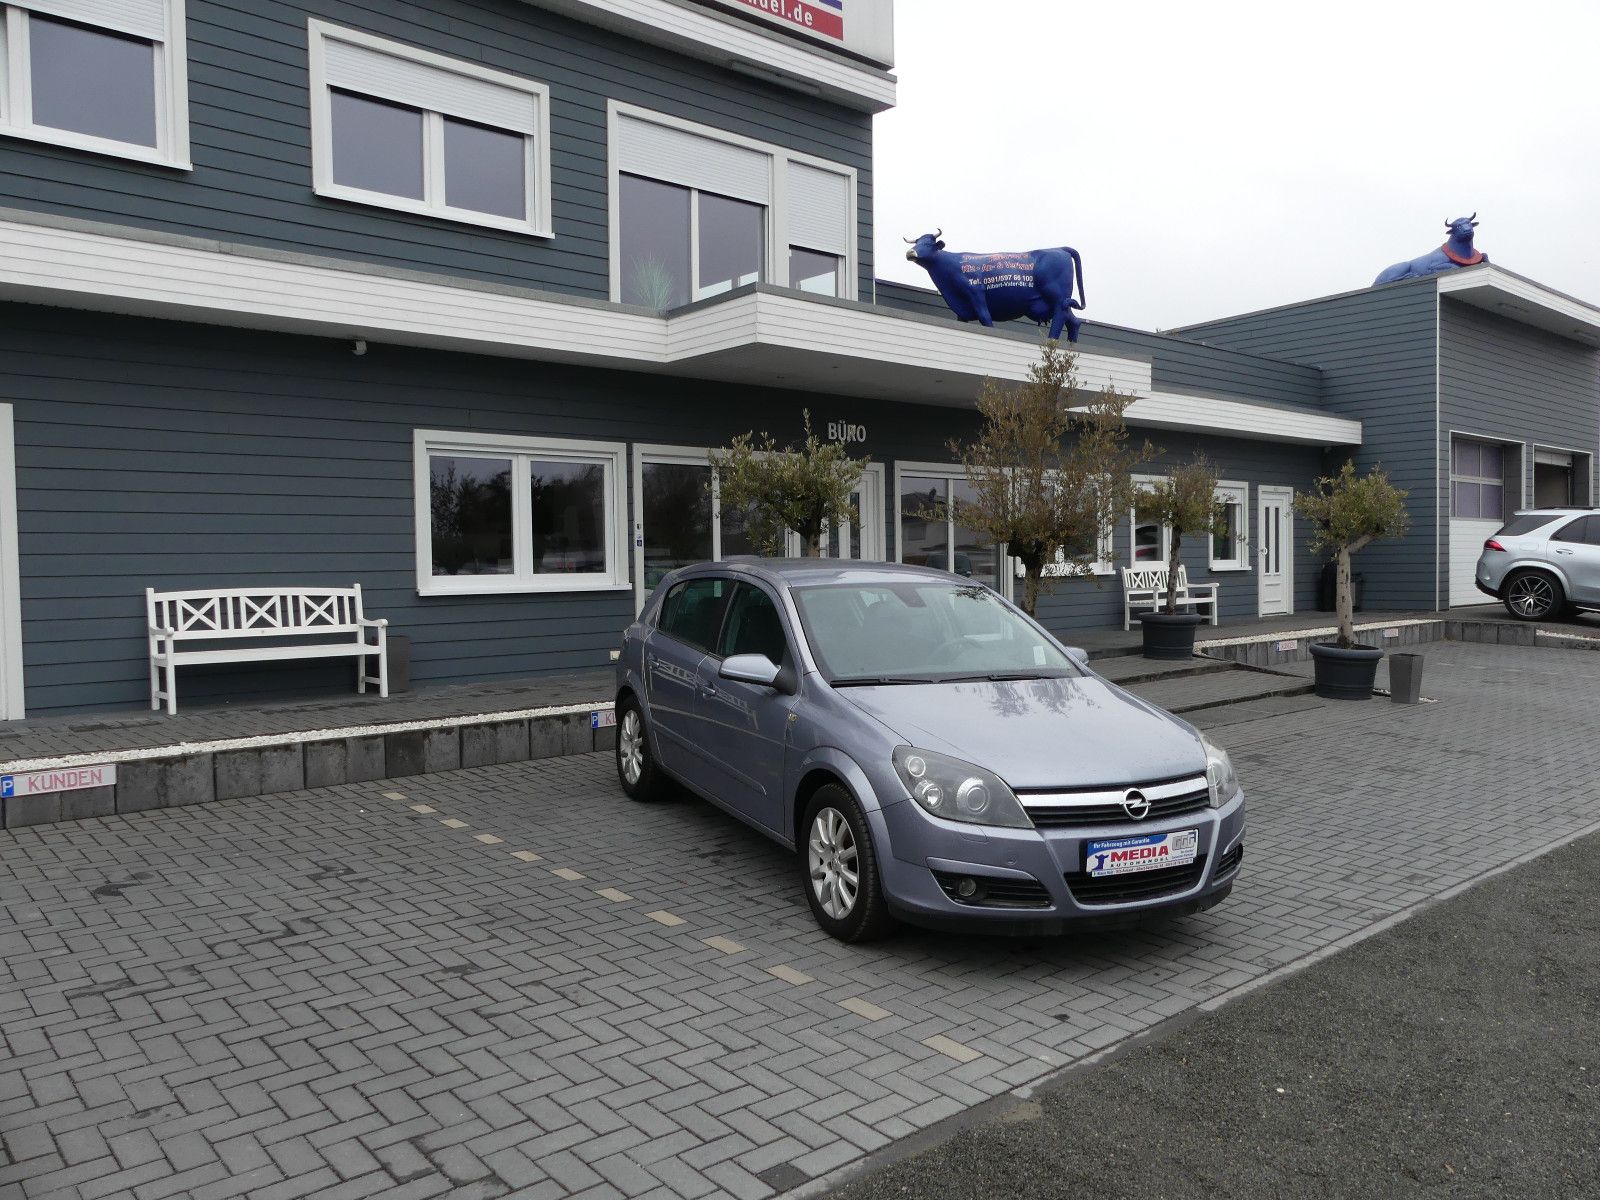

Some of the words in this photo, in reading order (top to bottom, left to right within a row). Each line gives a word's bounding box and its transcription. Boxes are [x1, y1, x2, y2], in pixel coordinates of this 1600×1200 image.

[28, 769, 102, 792] KUNDEN
[1110, 845, 1169, 862] MEDIA
[1110, 856, 1169, 868] AUTOHANDEL
